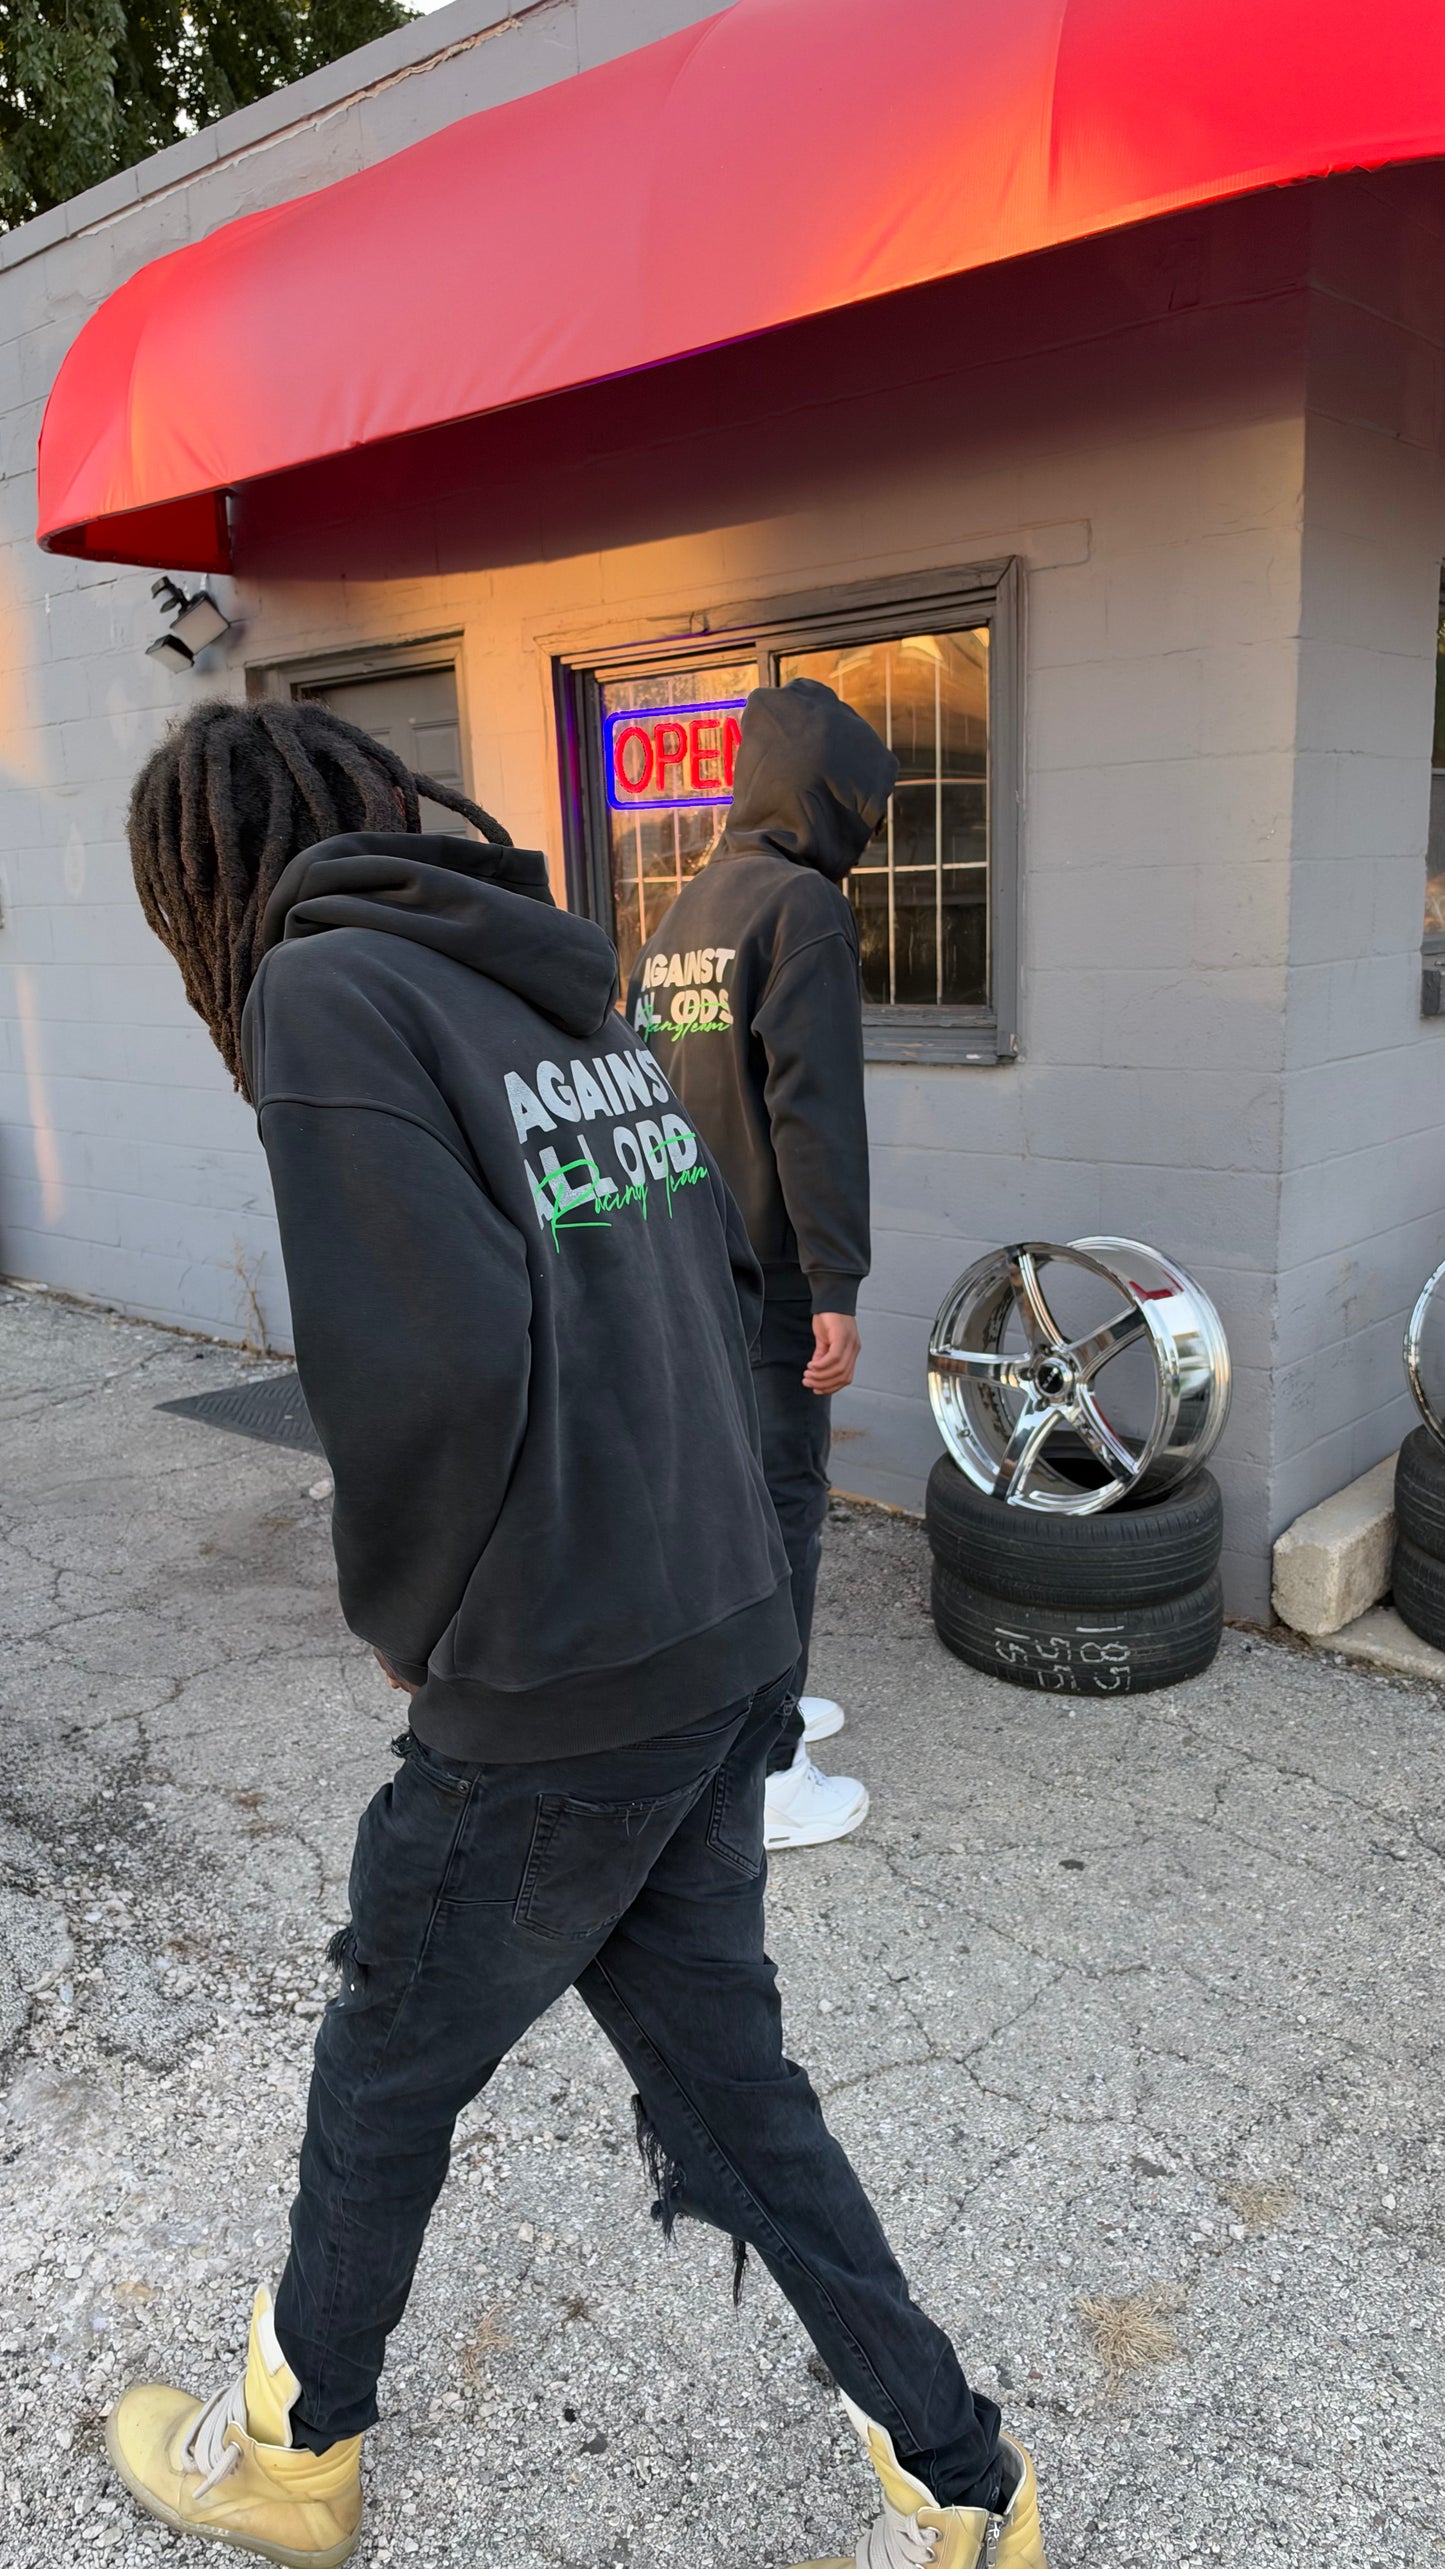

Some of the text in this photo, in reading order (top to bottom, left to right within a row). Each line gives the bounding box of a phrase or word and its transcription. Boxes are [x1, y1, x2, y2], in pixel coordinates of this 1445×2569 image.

[670, 988, 734, 1025] ODDS
[504, 1048, 670, 1144] AGAINS
[613, 1113, 698, 1187] ODD
